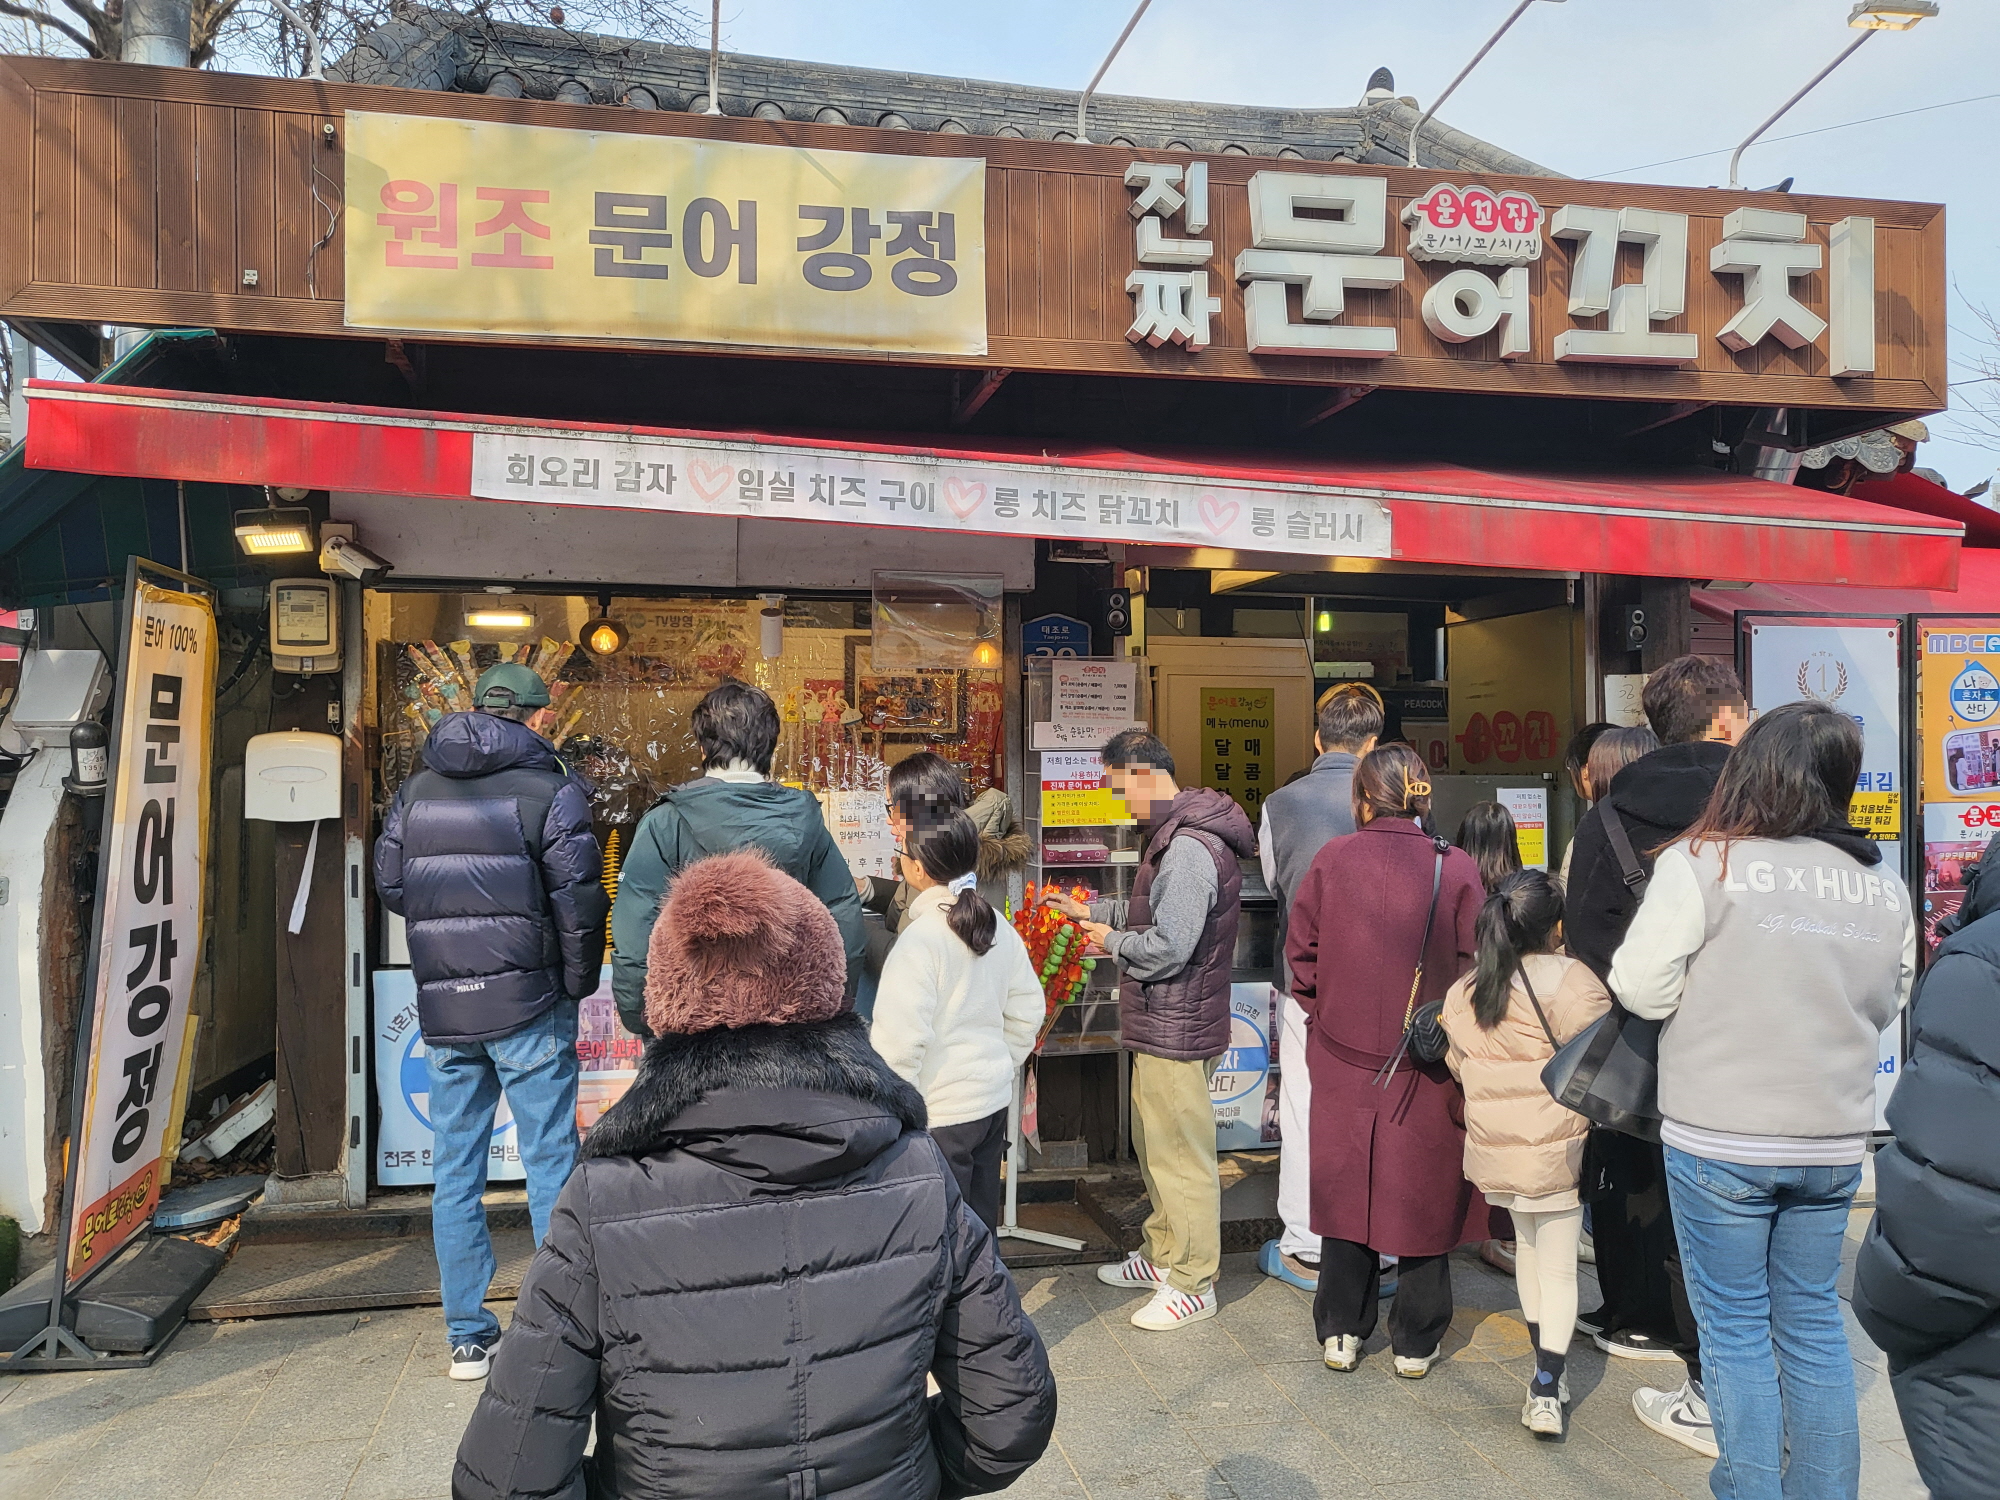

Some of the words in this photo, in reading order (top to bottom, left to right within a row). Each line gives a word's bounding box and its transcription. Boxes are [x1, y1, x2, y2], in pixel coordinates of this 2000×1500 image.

[1435, 193, 1528, 232] 문꼬집
[376, 179, 554, 270] 원조
[588, 191, 758, 285] 문어
[796, 204, 958, 297] 강정
[1124, 161, 1221, 353] 진짜
[1235, 168, 1876, 380] 문어꼬치
[505, 453, 601, 491] 회오리
[614, 460, 677, 496] 감자
[736, 468, 796, 503] 임실
[808, 473, 867, 509] 치즈
[878, 478, 936, 513] 구이
[993, 486, 1021, 518] 롱
[1031, 488, 1087, 522] 치즈
[1098, 493, 1180, 529] 닭꼬치
[1250, 505, 1276, 537] 롱
[1286, 510, 1364, 543] 슬러시
[144, 615, 165, 649] 문어
[169, 622, 198, 655] 100%
[1963, 675, 1976, 688] 나
[1404, 699, 1443, 709] PEACOCK
[1961, 690, 1981, 701] 혼자
[1966, 703, 1987, 715] 산다
[1046, 756, 1062, 765] 저희
[1065, 756, 1087, 766] 업소는
[1050, 781, 1066, 790] 진짜
[1068, 781, 1082, 790] 문어
[1857, 771, 1893, 792] 튀김
[1859, 804, 1893, 814] 처음보는
[1874, 815, 1892, 826] 튀김
[1719, 860, 1777, 894] LG
[1812, 865, 1902, 912] HUFS
[111, 672, 184, 1165] 문어강정
[1756, 913, 1786, 934] LG
[1790, 916, 1838, 935] Global
[1842, 922, 1882, 943] School
[456, 981, 486, 993] MILLET
[1235, 1001, 1261, 1020] 이규형
[575, 1040, 608, 1060] 문어
[610, 1039, 643, 1058] 꼬치
[384, 1150, 417, 1168] 전주
